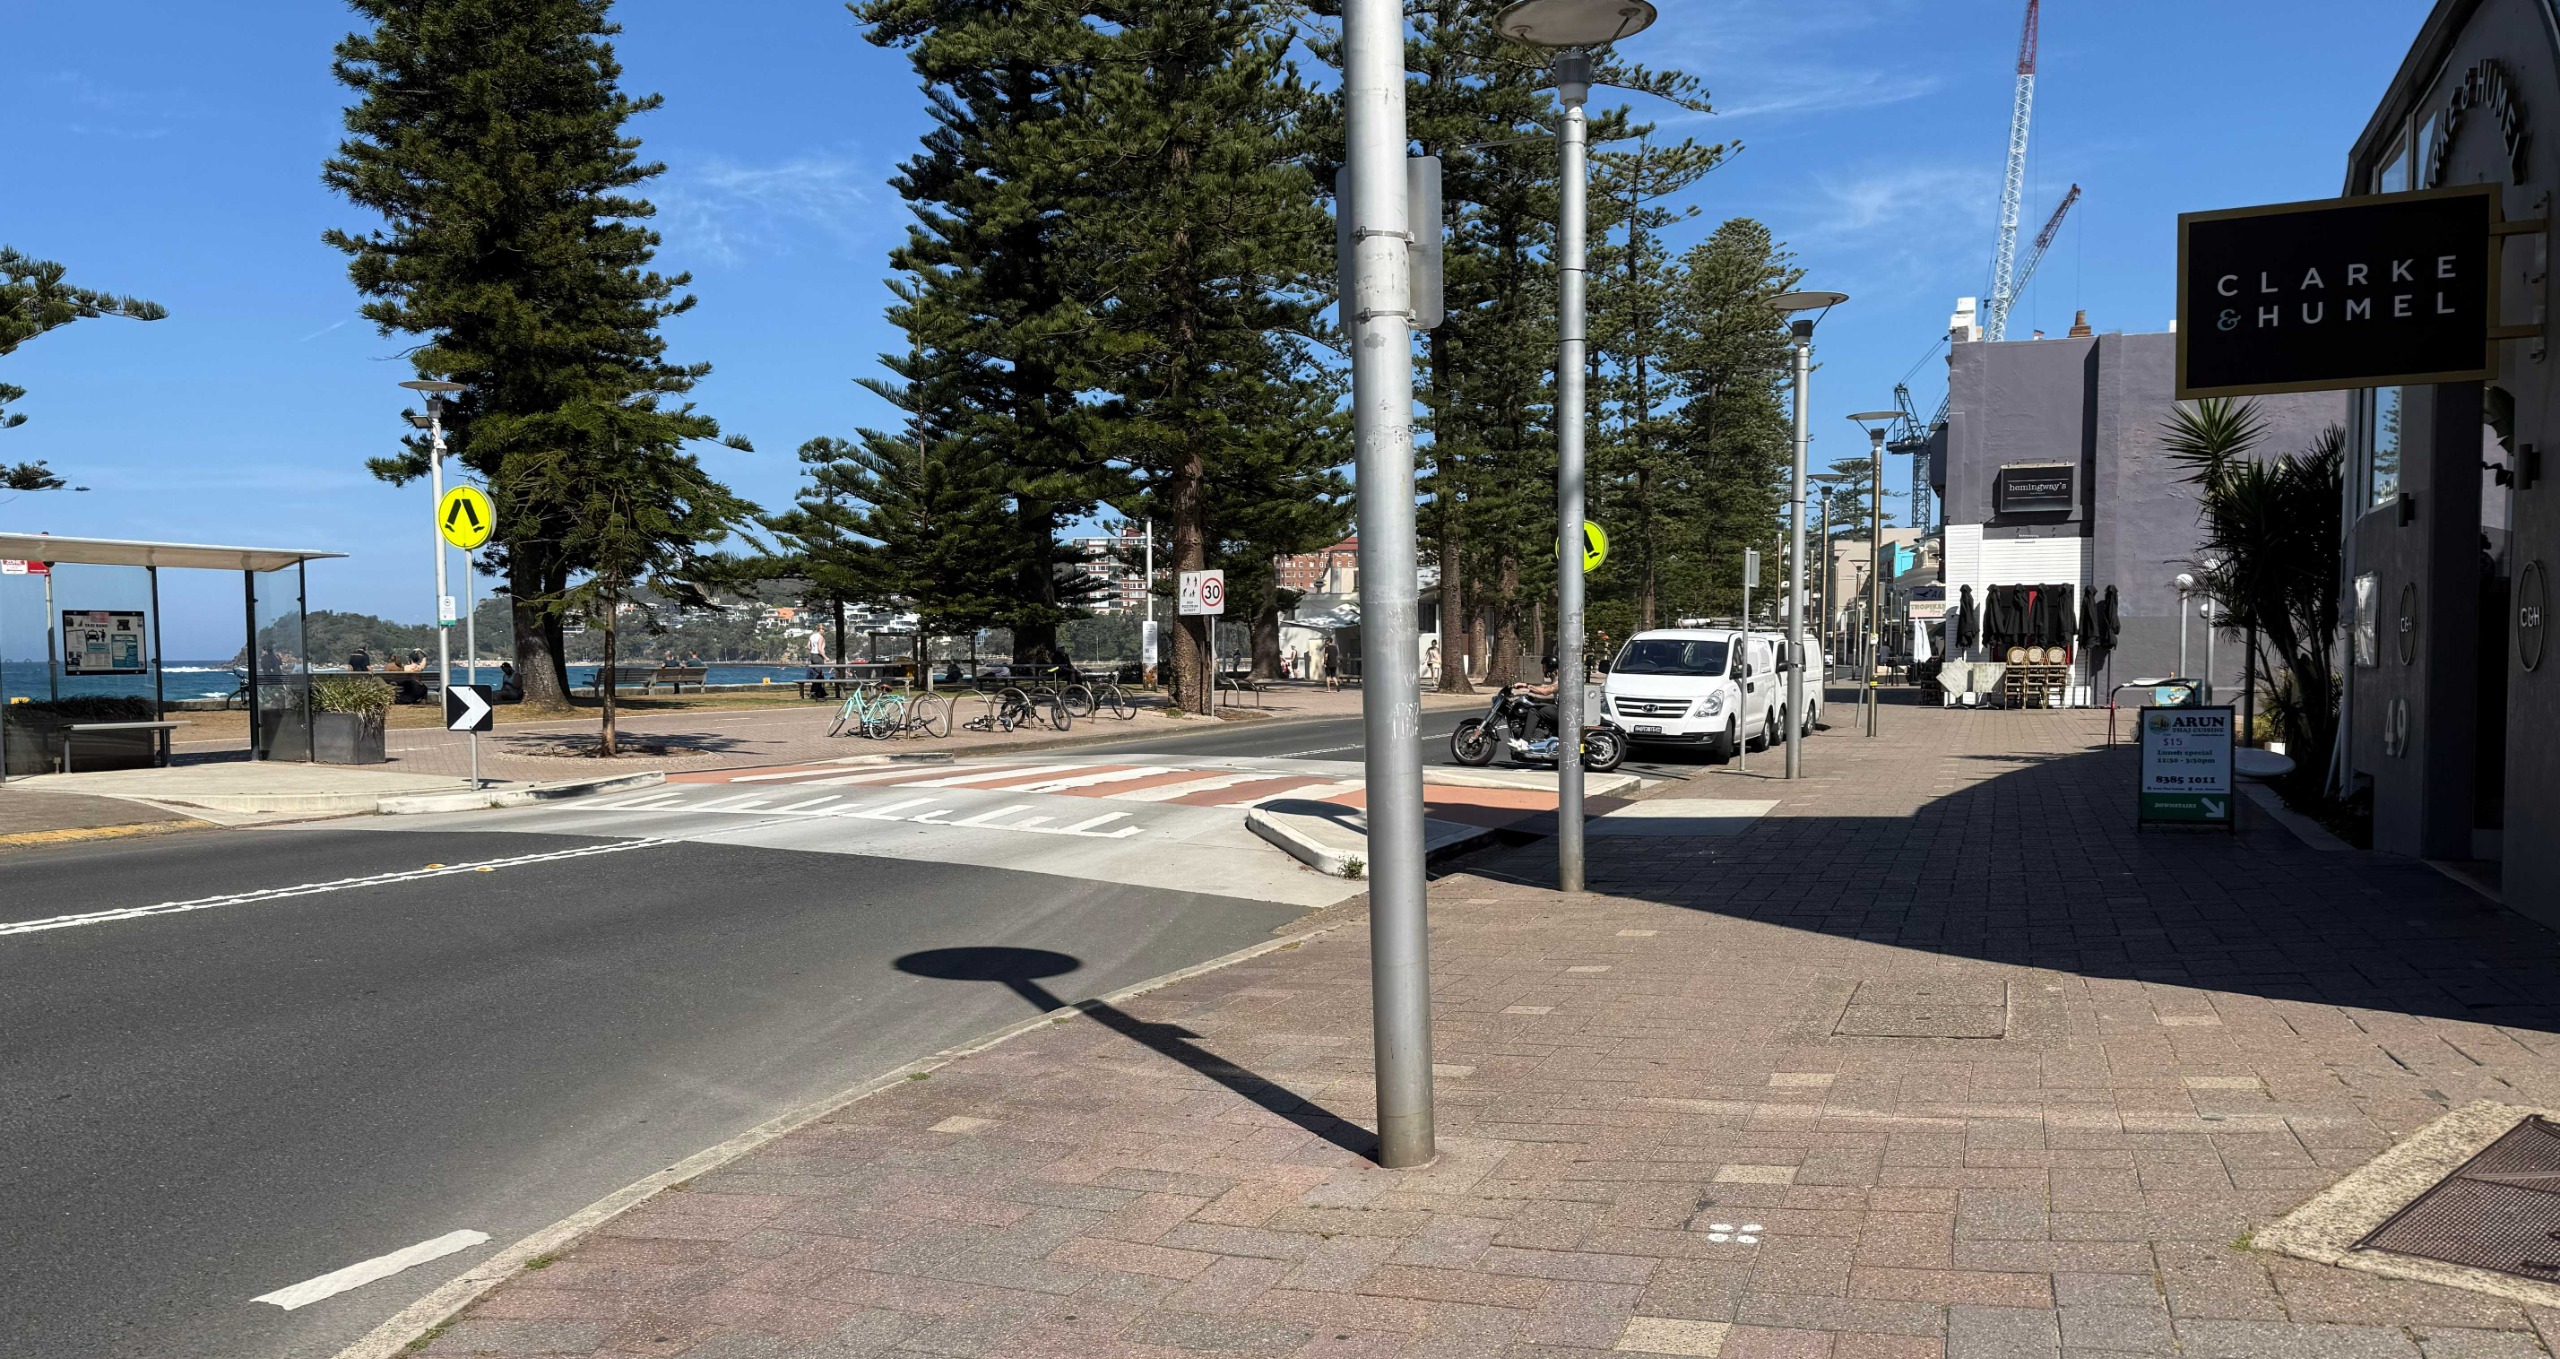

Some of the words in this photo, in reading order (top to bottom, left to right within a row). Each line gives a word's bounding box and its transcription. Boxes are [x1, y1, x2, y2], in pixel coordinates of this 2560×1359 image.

[2217, 255, 2457, 297] CLARKE
[2217, 308, 2241, 331] &
[2258, 291, 2456, 328] HUMEL
[2008, 481, 2067, 492] hemingway's
[1205, 585, 1220, 599] 30
[2521, 607, 2540, 627] C&H
[2172, 716, 2225, 727] ARUN
[2384, 699, 2408, 759] 49
[2163, 737, 2183, 746] $15
[2184, 749, 2213, 757] special
[2188, 776, 2216, 784] 1011
